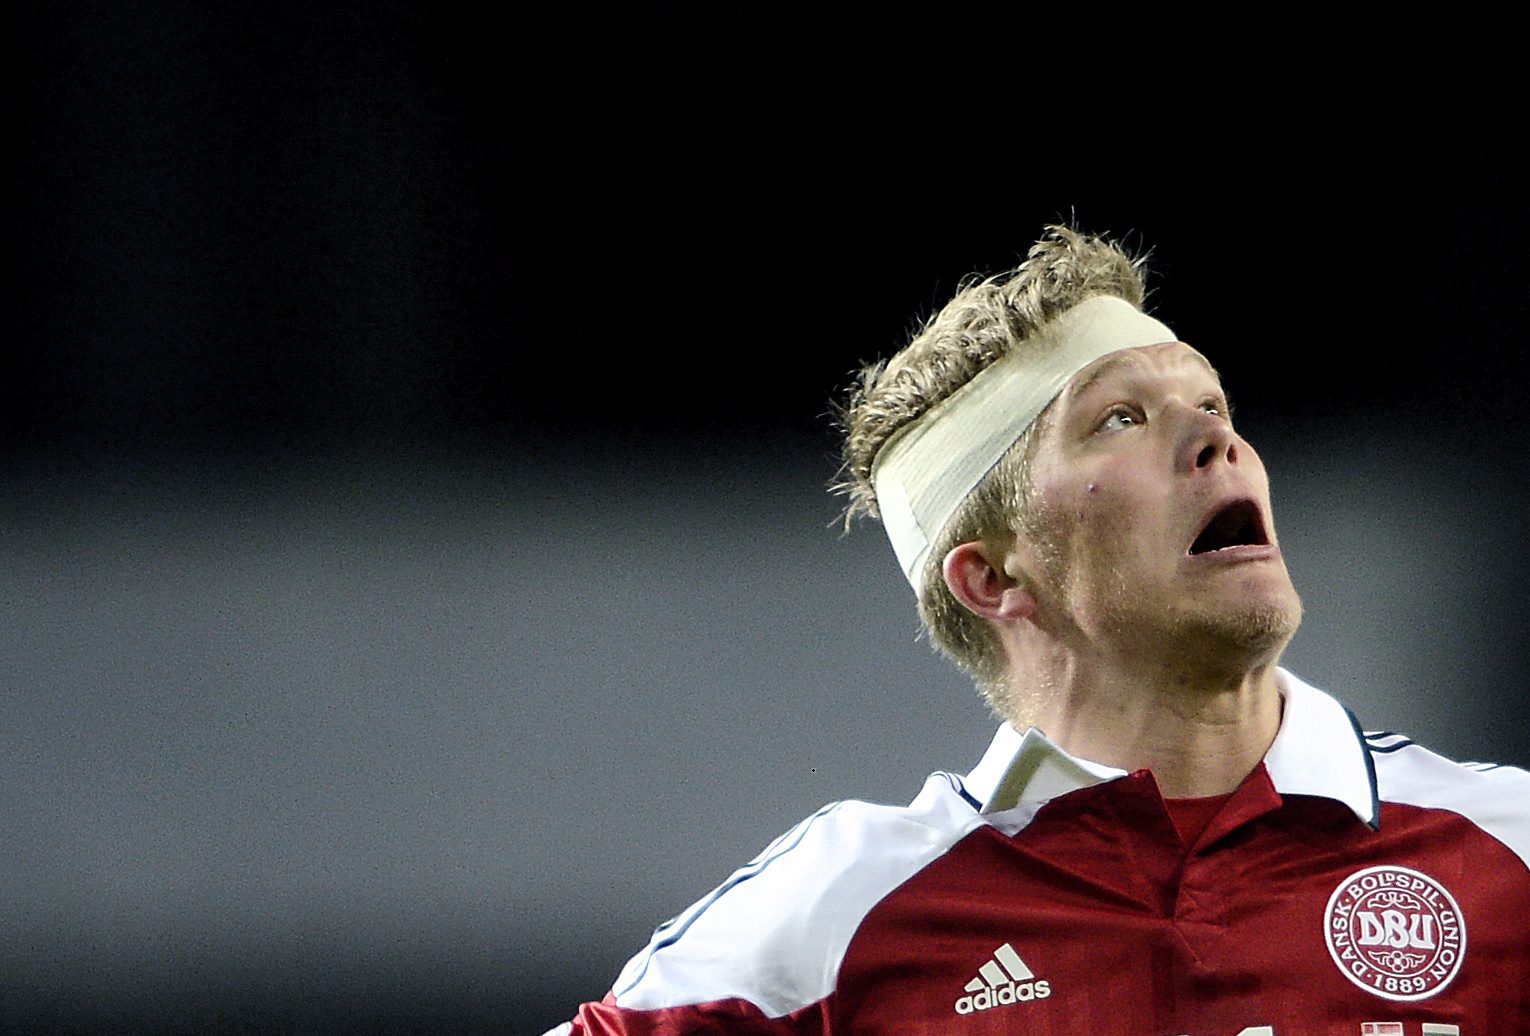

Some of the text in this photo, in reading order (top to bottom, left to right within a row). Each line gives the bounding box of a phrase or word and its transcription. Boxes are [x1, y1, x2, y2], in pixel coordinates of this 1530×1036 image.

[1332, 901, 1368, 978] DANSK
[1356, 909, 1436, 950] DBU
[954, 980, 1051, 1014] adidas
[1374, 973, 1426, 994] 1889
